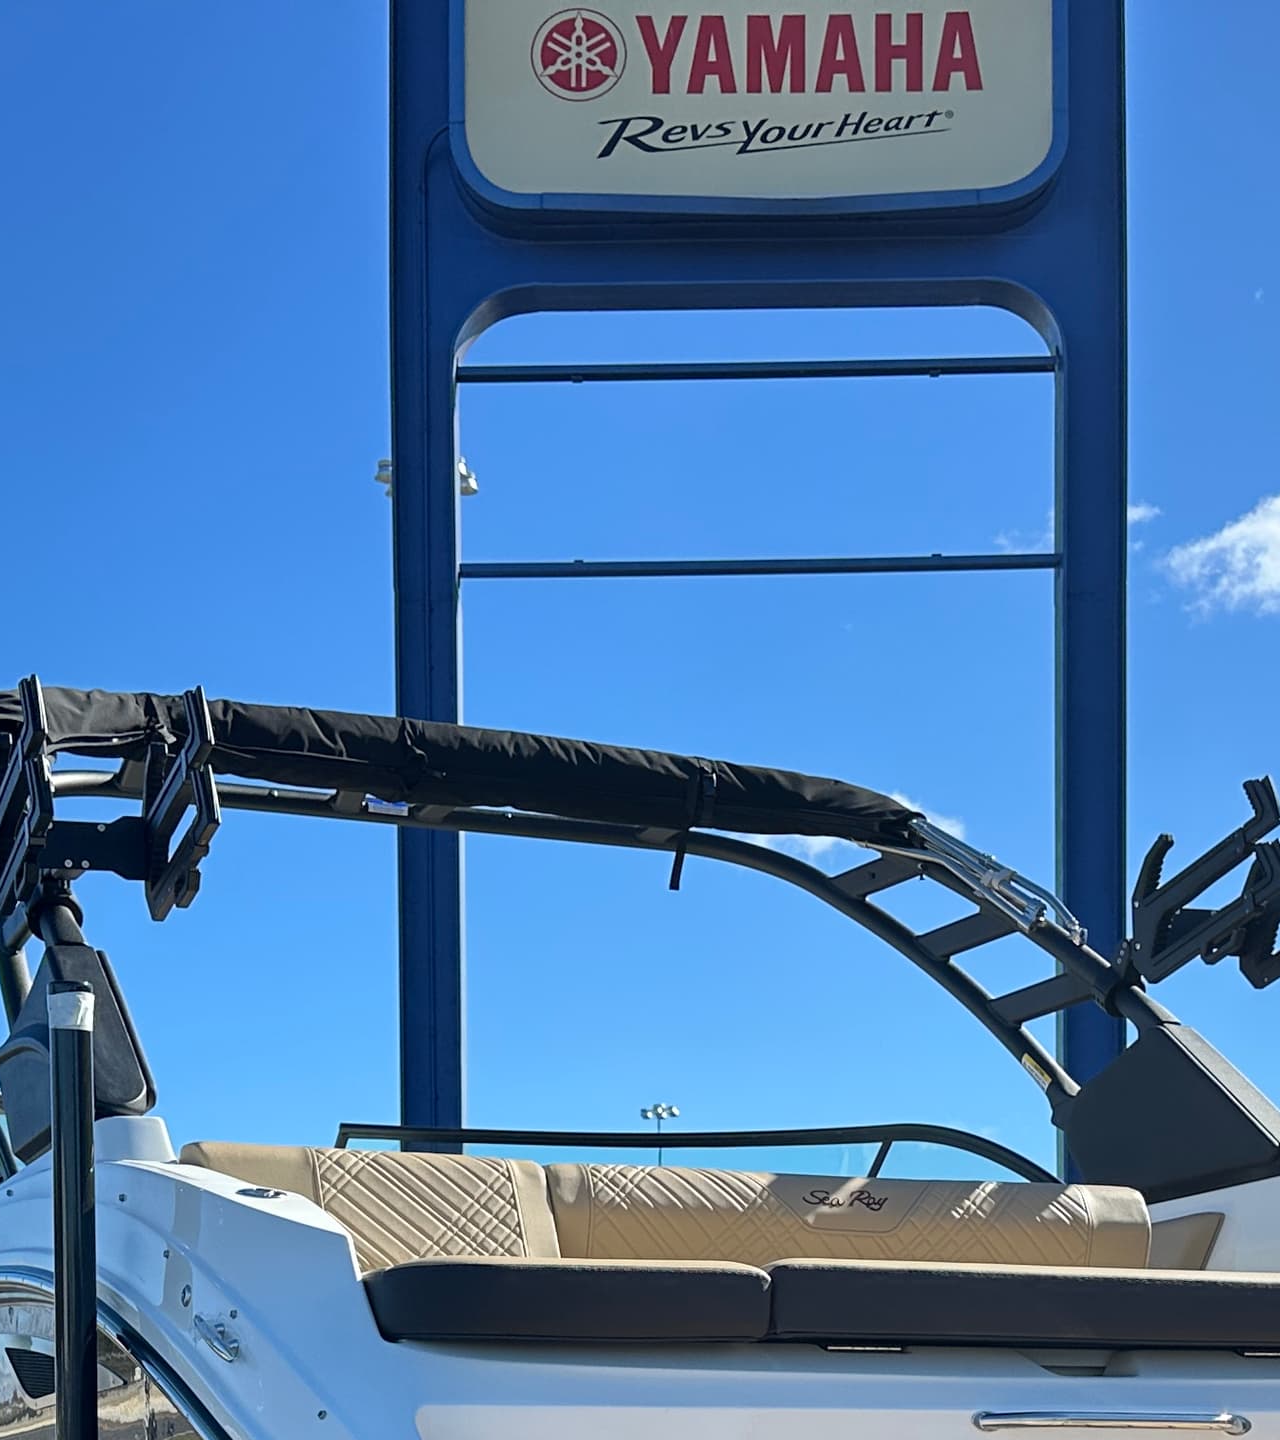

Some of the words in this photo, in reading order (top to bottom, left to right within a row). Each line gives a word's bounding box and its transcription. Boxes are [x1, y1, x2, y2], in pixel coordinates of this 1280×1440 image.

[635, 11, 984, 95] YAMAHA
[596, 115, 736, 160] Revs
[734, 117, 835, 155] Your
[801, 1189, 846, 1209] Sea
[847, 1189, 889, 1212] Ray
